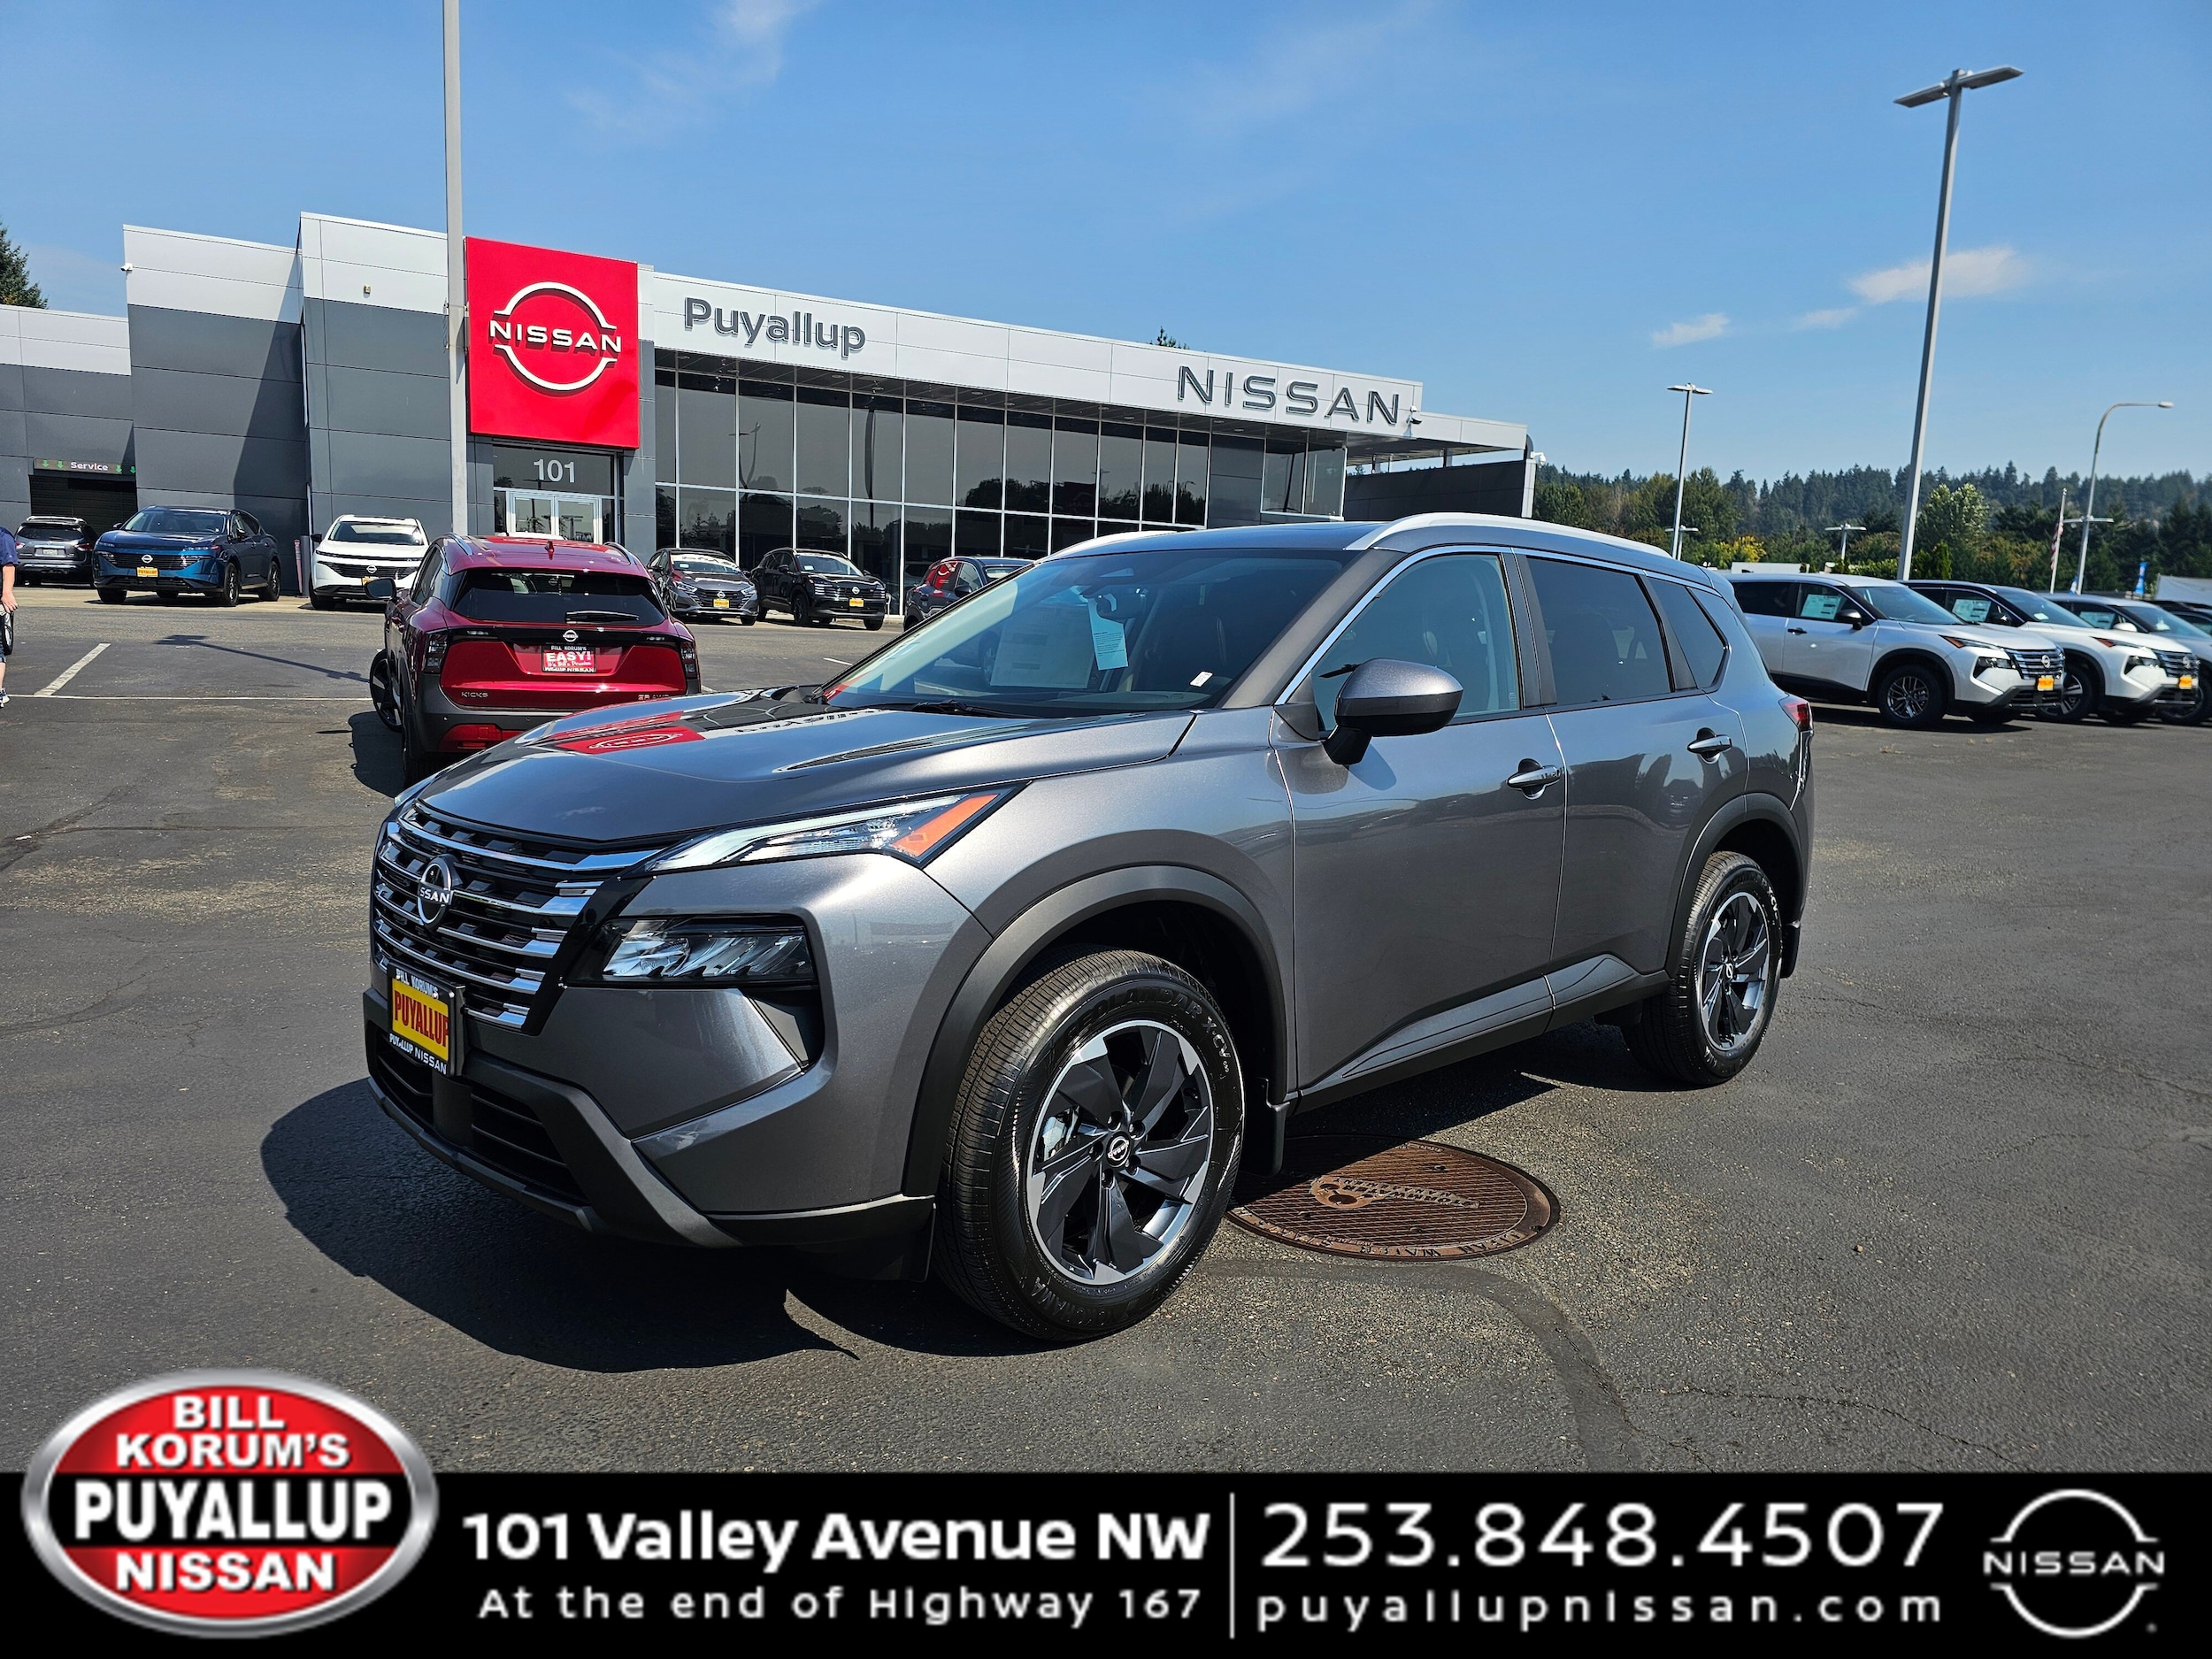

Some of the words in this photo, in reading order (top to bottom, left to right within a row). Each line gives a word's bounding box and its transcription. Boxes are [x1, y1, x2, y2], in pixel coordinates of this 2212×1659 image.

[489, 319, 621, 353] NISSAN
[685, 296, 866, 357] Puyallup
[1178, 365, 1400, 426] NISSAN
[70, 461, 109, 472] Service
[534, 458, 575, 483] 101
[546, 650, 592, 663] EASY!
[394, 989, 449, 1048] PUYALLUP
[414, 1047, 447, 1075] NISSAN
